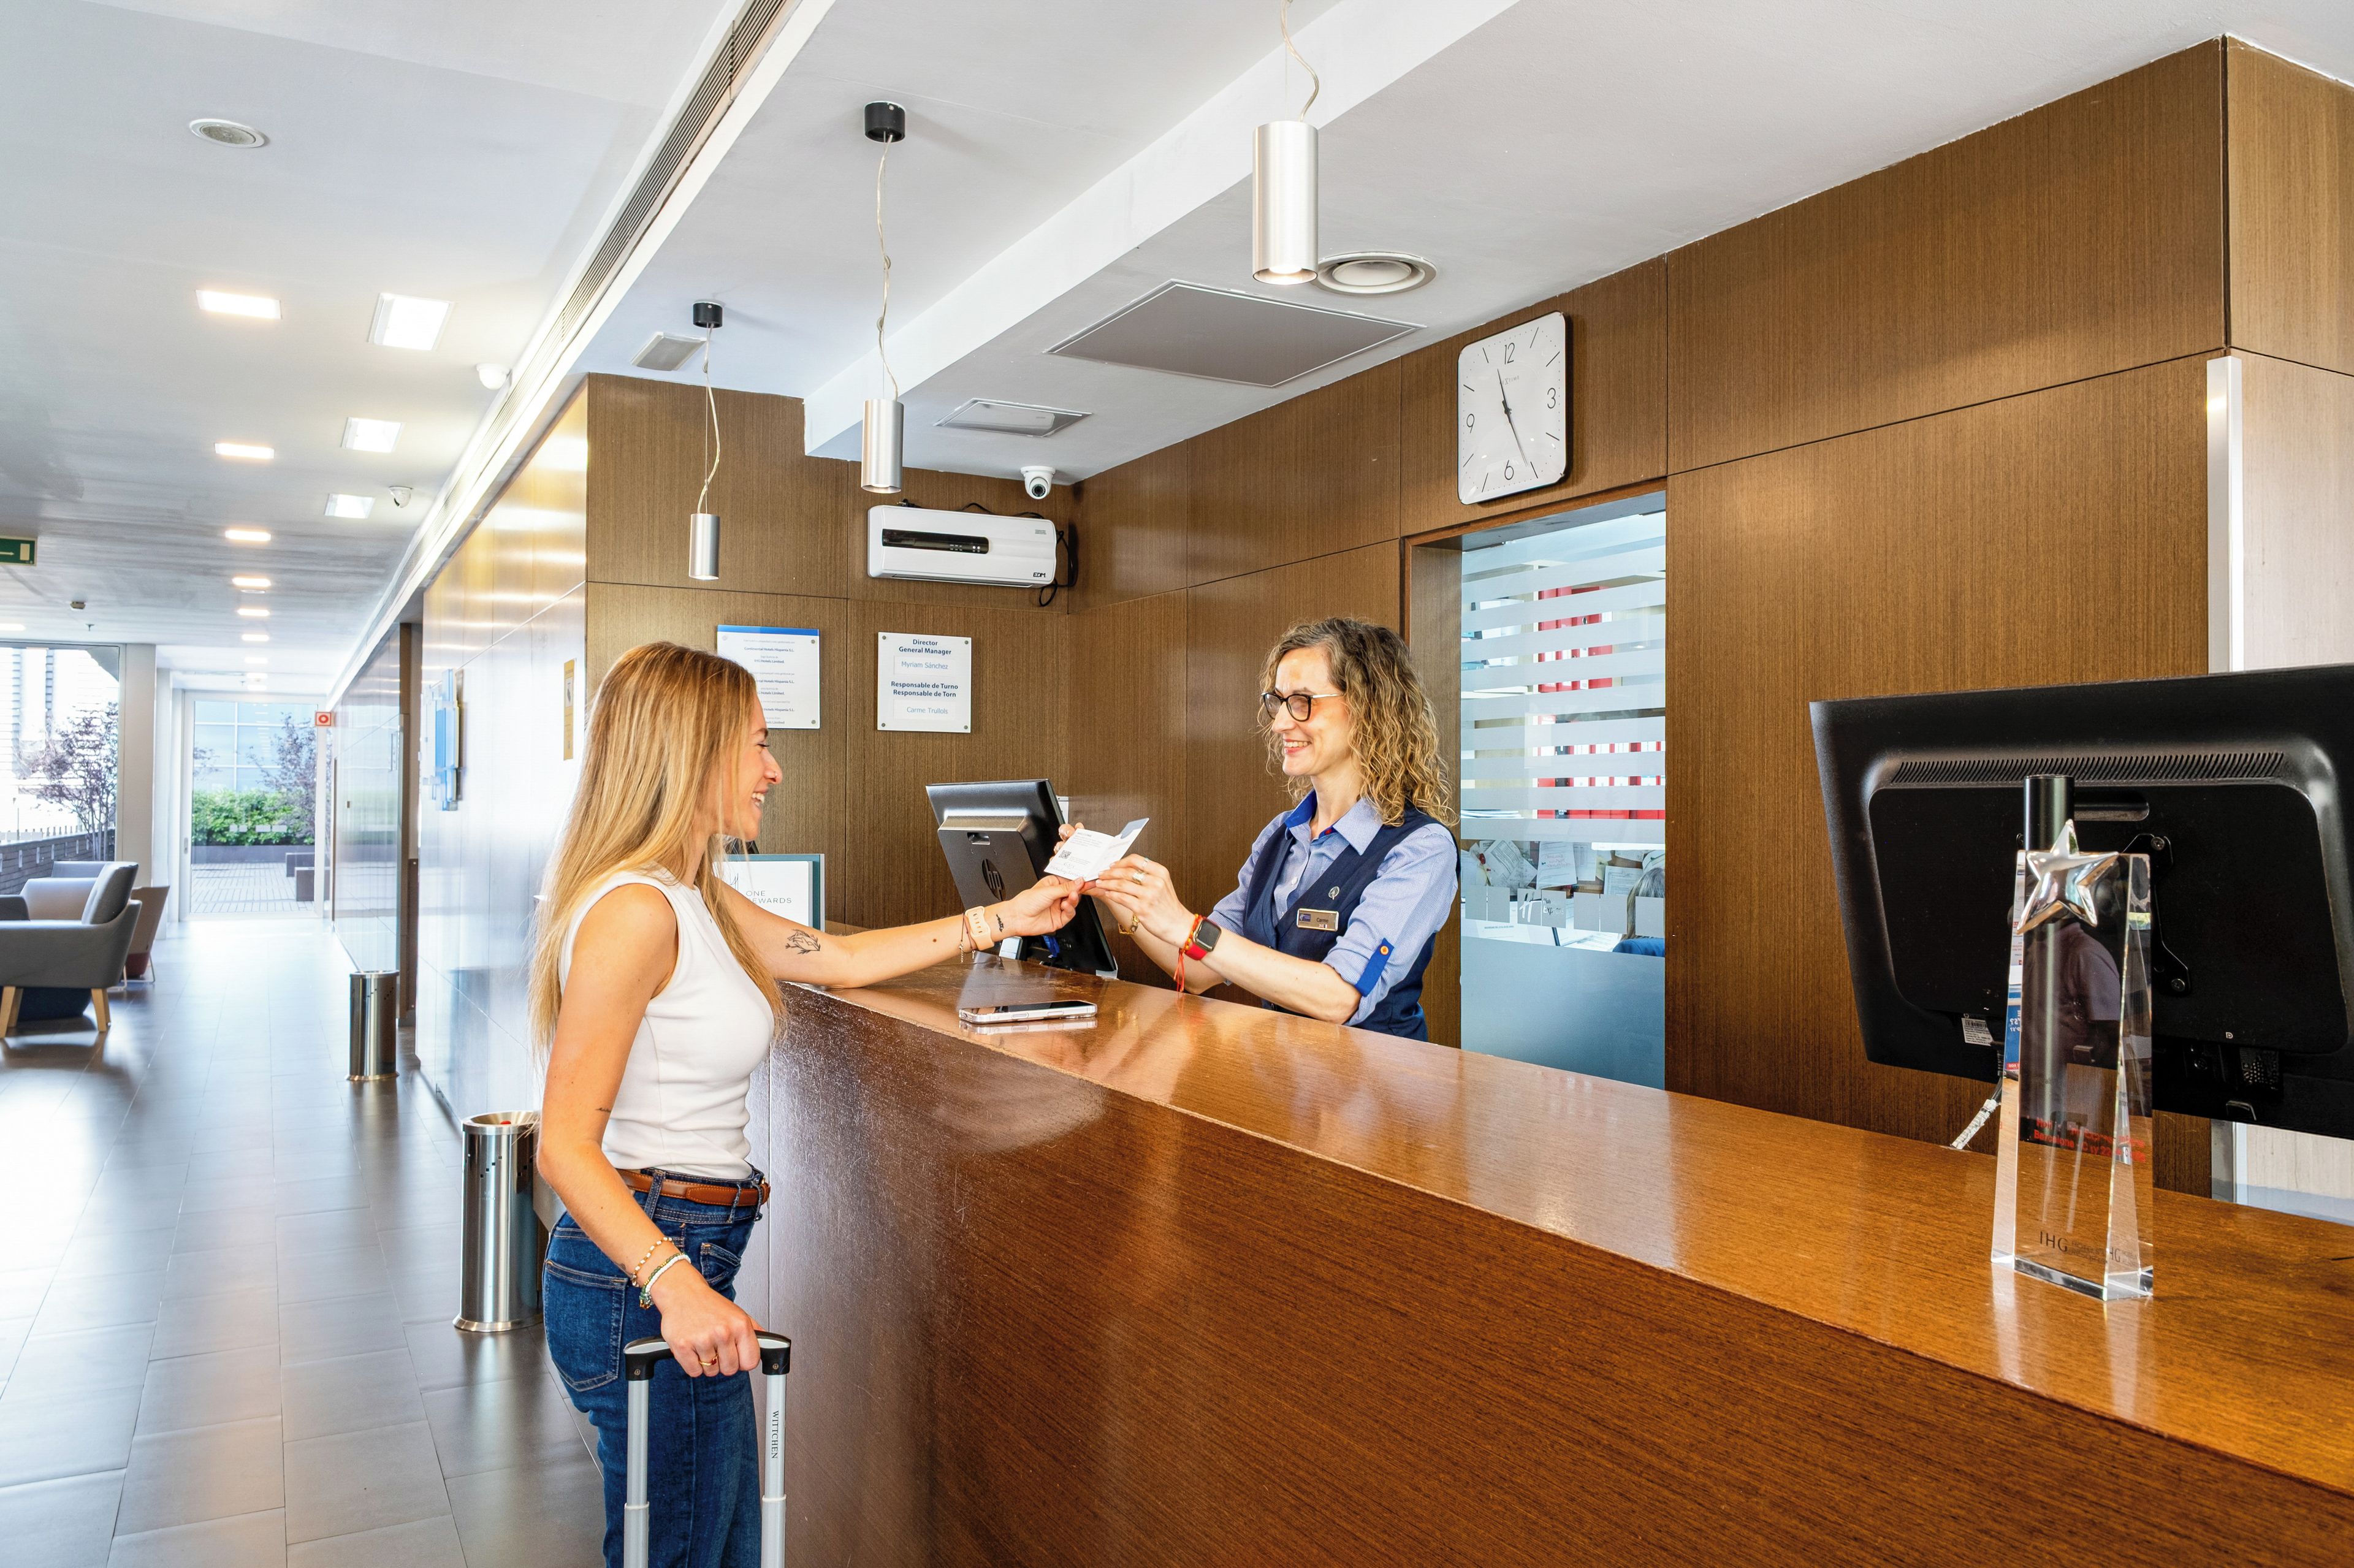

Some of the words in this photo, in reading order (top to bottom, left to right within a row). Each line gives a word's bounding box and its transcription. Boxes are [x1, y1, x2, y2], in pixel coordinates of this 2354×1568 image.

[1504, 342, 1515, 365] 12
[1547, 387, 1556, 409] 3
[1466, 413, 1474, 433] 9
[1504, 460, 1514, 481] 6
[2040, 1231, 2068, 1252] IHG
